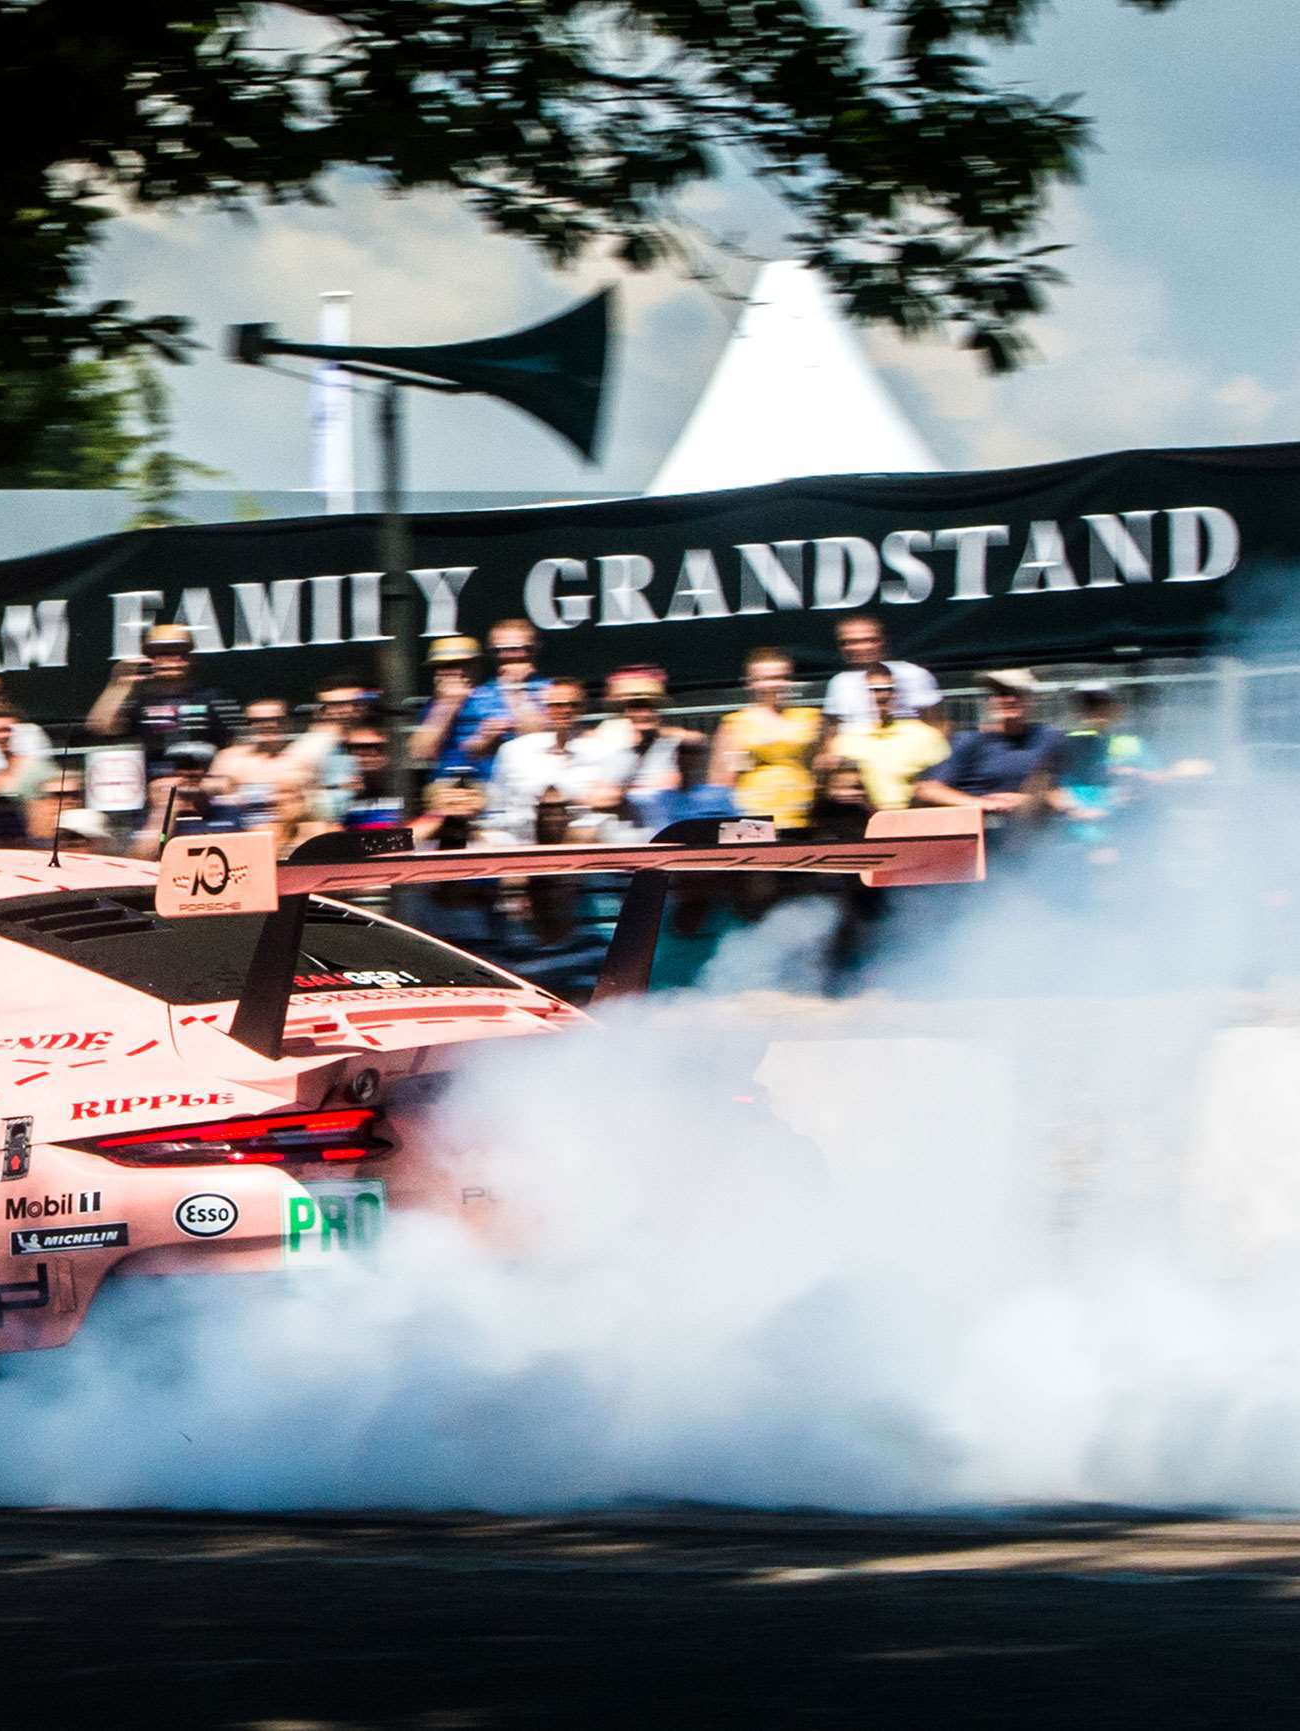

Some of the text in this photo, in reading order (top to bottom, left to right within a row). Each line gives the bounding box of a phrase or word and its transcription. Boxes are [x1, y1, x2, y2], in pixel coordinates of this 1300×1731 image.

[523, 506, 1241, 630] GRANDSTAND
[187, 846, 229, 896] 70
[179, 902, 241, 912] PORSCHE
[71, 1092, 235, 1121] RIPPLE
[5, 1193, 73, 1220] Mobil
[44, 1231, 119, 1247] MICHELIN
